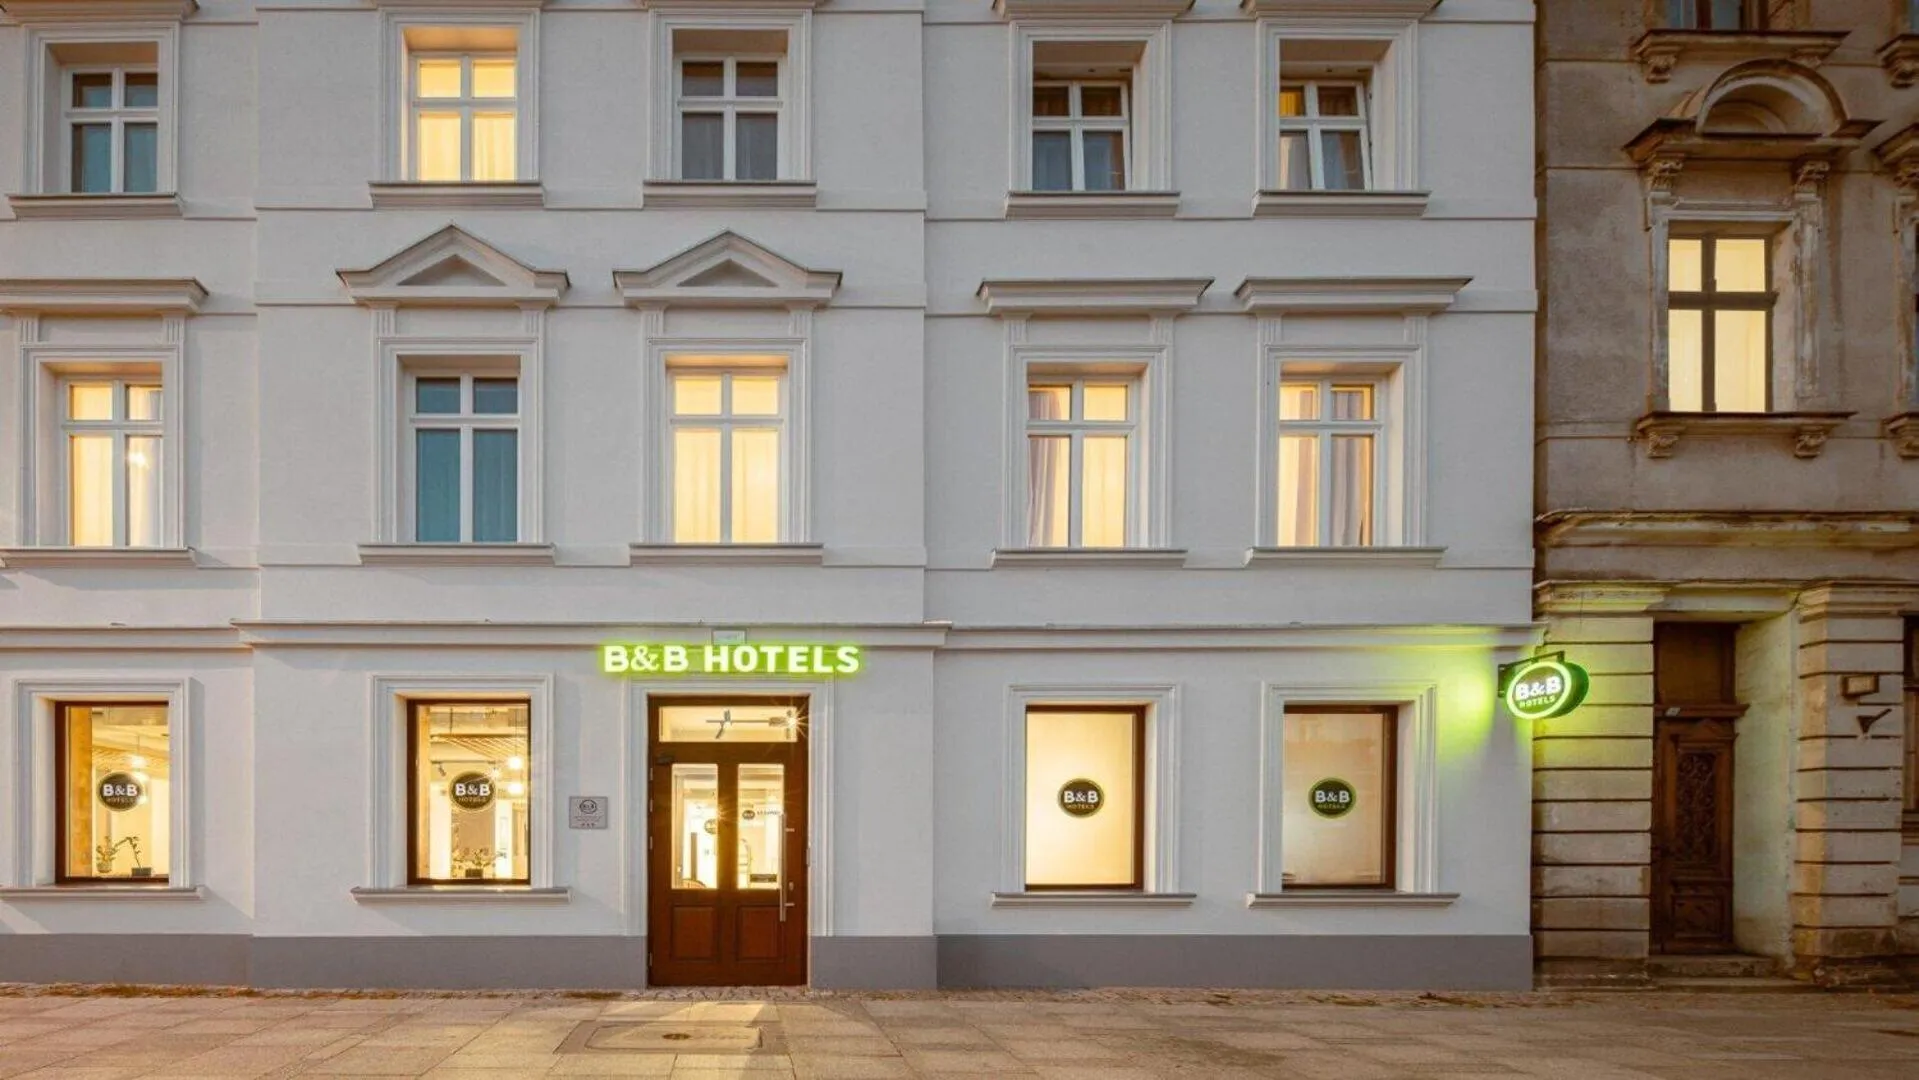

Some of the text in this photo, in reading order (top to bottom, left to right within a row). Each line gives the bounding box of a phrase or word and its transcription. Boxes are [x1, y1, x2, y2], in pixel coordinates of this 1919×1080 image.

[603, 645, 860, 673] B&B HOTELS
[1515, 676, 1562, 701] B&B
[1519, 695, 1556, 708] HOTELS
[103, 783, 138, 797] B&B
[455, 783, 491, 797] B&B
[1063, 790, 1099, 803] B&B
[1315, 790, 1350, 803] B&B
